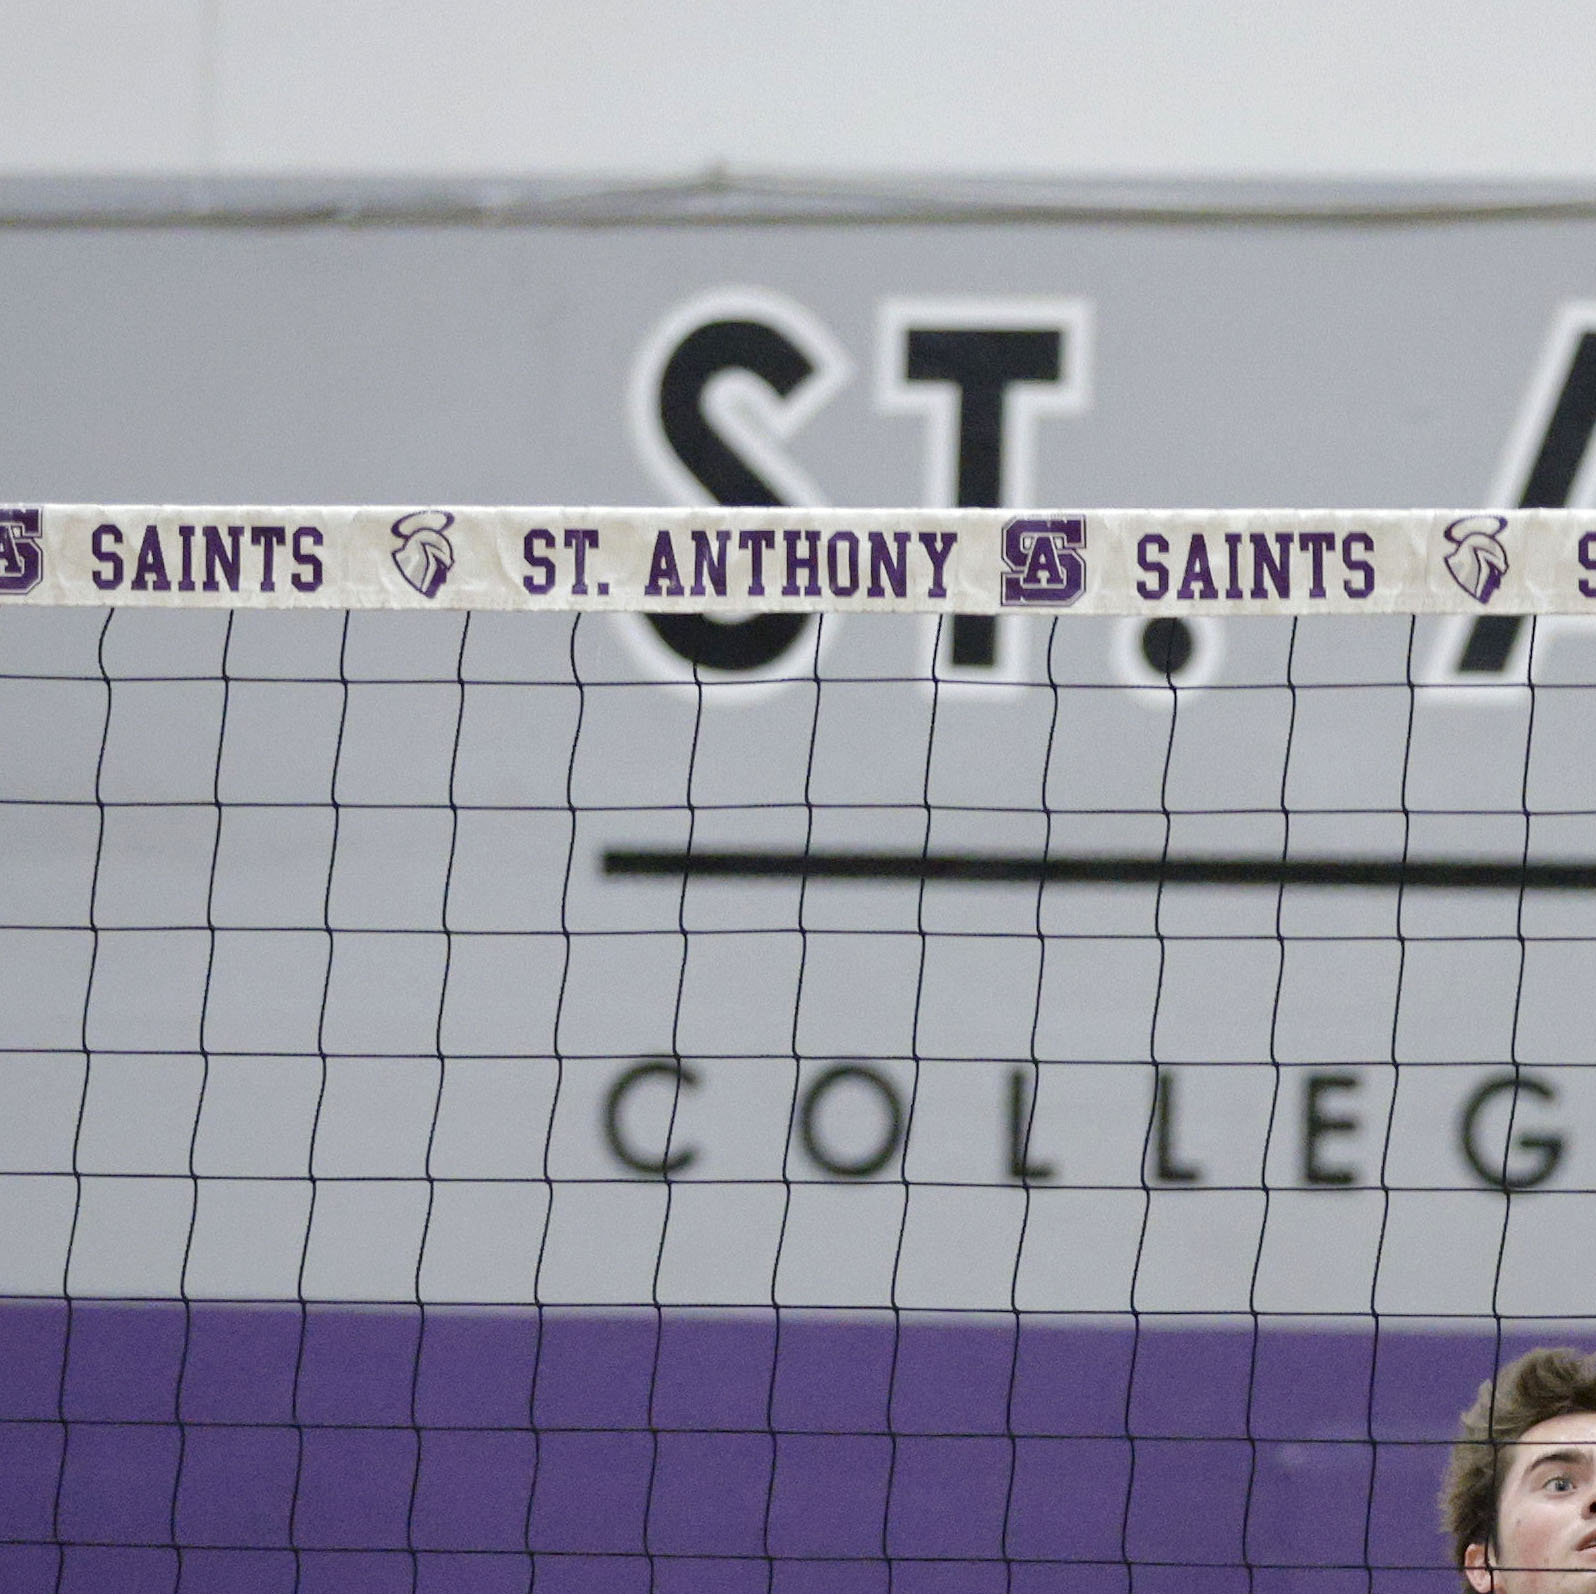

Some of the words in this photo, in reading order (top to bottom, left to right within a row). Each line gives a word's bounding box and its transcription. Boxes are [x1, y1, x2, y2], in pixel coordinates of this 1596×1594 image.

[91, 523, 325, 593] SAINTS
[523, 527, 610, 595] ST.
[644, 529, 958, 599] ANTHONY
[1136, 531, 1375, 600] SAINTS
[632, 290, 1236, 700] ST.
